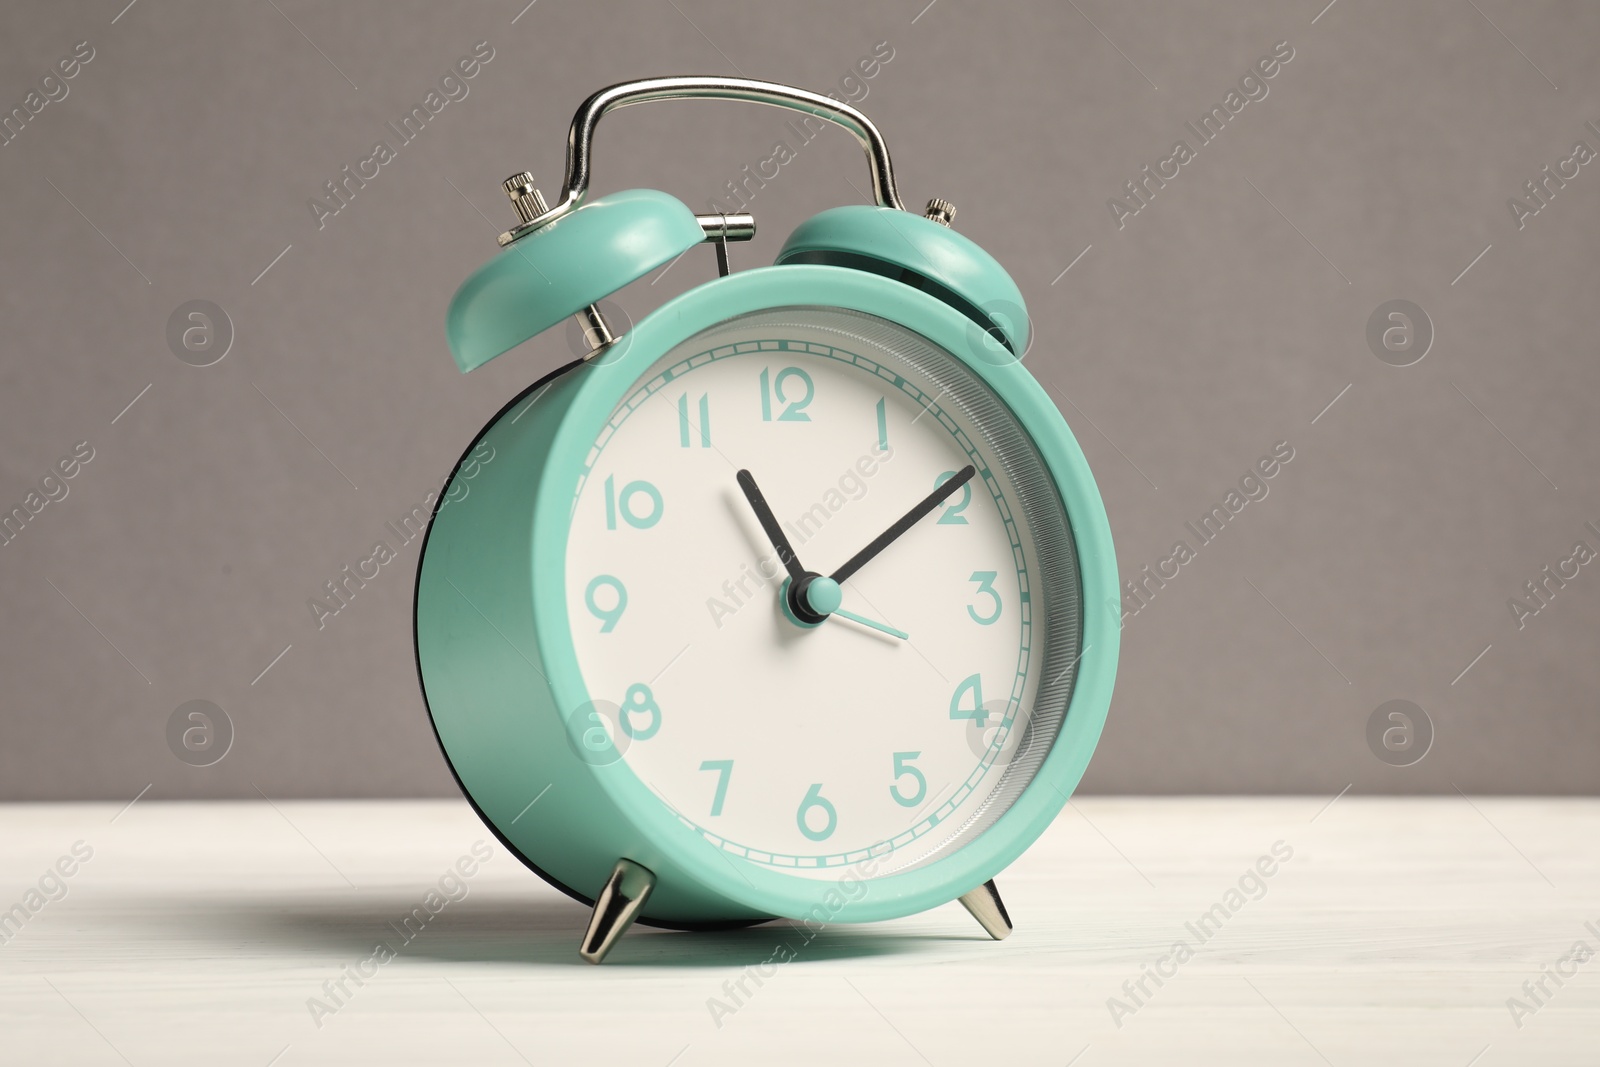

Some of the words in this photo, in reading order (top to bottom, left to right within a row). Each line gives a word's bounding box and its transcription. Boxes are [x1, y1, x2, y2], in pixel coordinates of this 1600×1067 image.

[679, 391, 712, 449] 11
[761, 366, 814, 422] 12
[877, 396, 889, 450] 1
[605, 474, 664, 531] 10
[934, 471, 971, 525] 2
[585, 575, 628, 633] 9
[967, 571, 1002, 626] 3
[618, 683, 662, 741] 8
[949, 672, 990, 729] 4
[699, 759, 735, 818] 7
[889, 751, 927, 808] 5
[797, 783, 838, 842] 6
